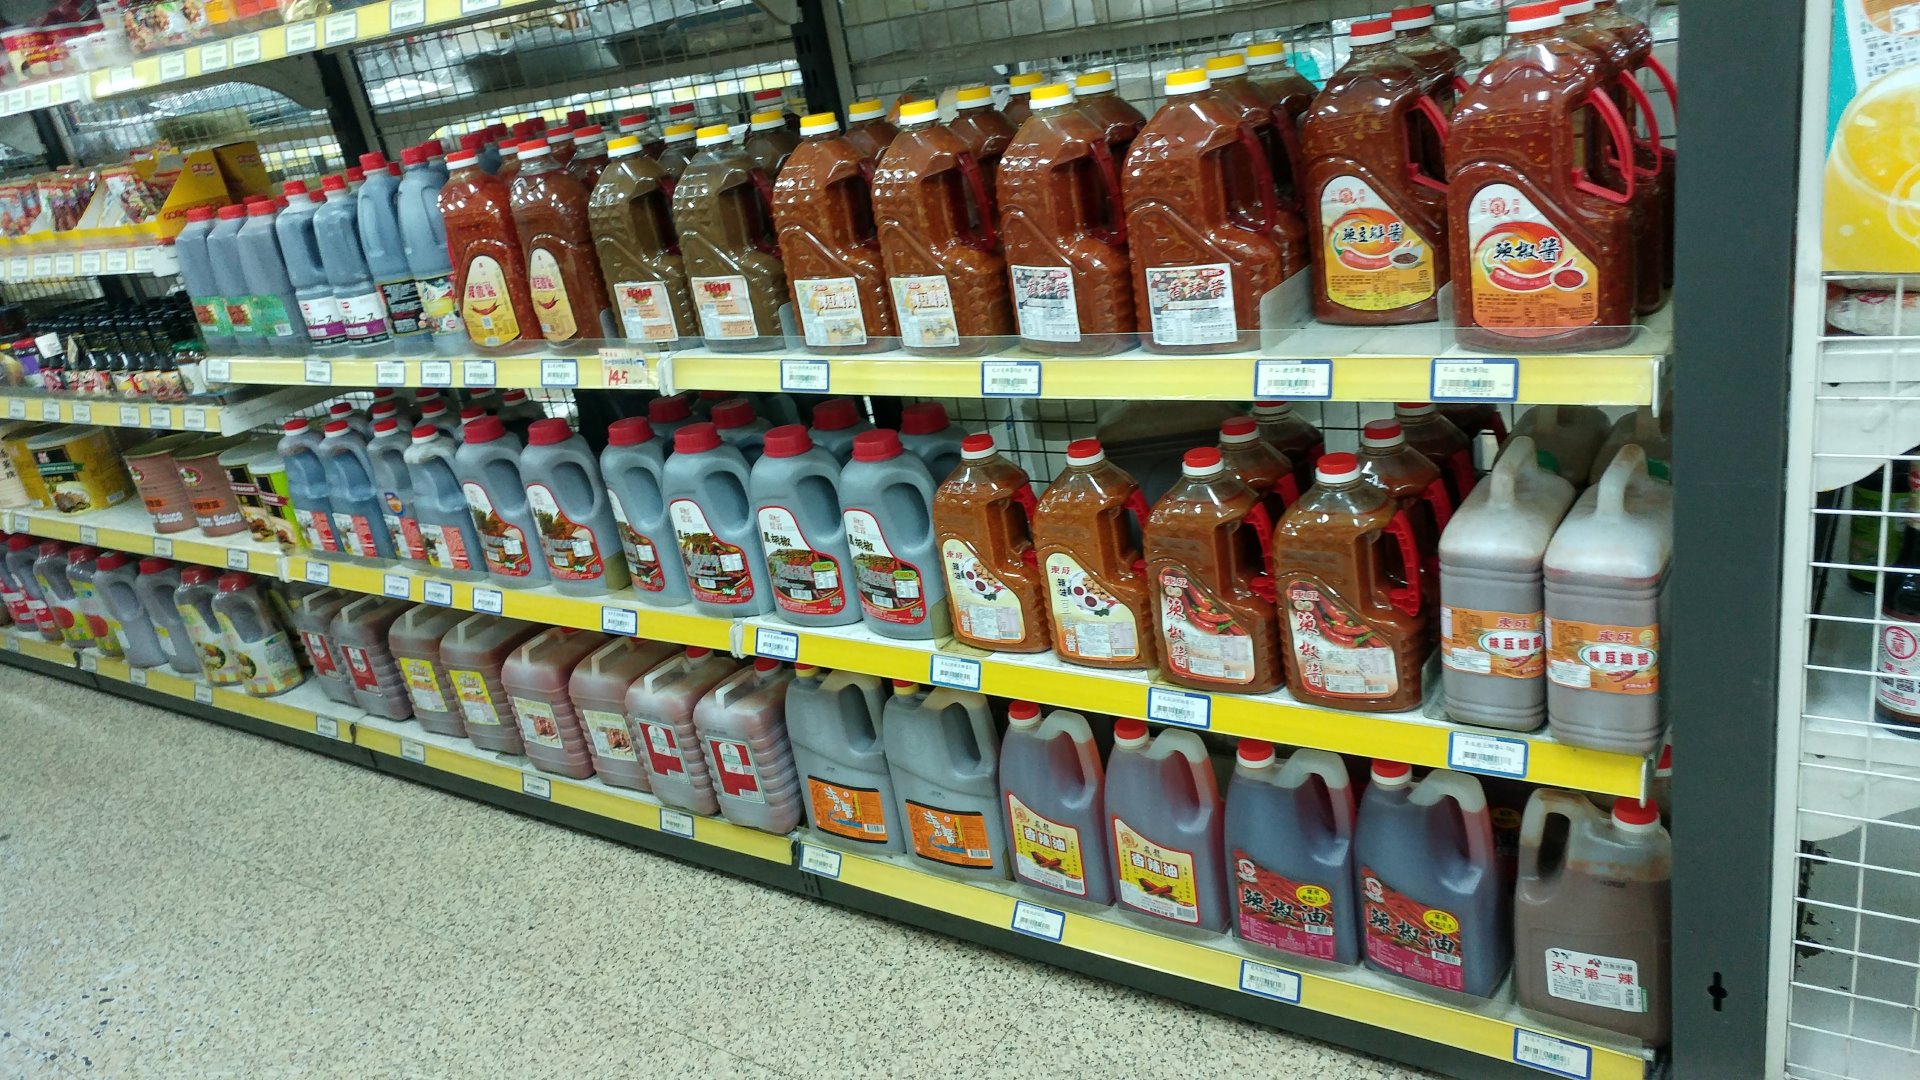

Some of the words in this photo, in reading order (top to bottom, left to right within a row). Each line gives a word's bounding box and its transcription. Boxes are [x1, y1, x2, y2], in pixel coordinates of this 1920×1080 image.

[1242, 886, 1328, 926] 辣椒油
[1368, 906, 1455, 954] 辣椒油
[1551, 960, 1634, 985] 天下第一辣
